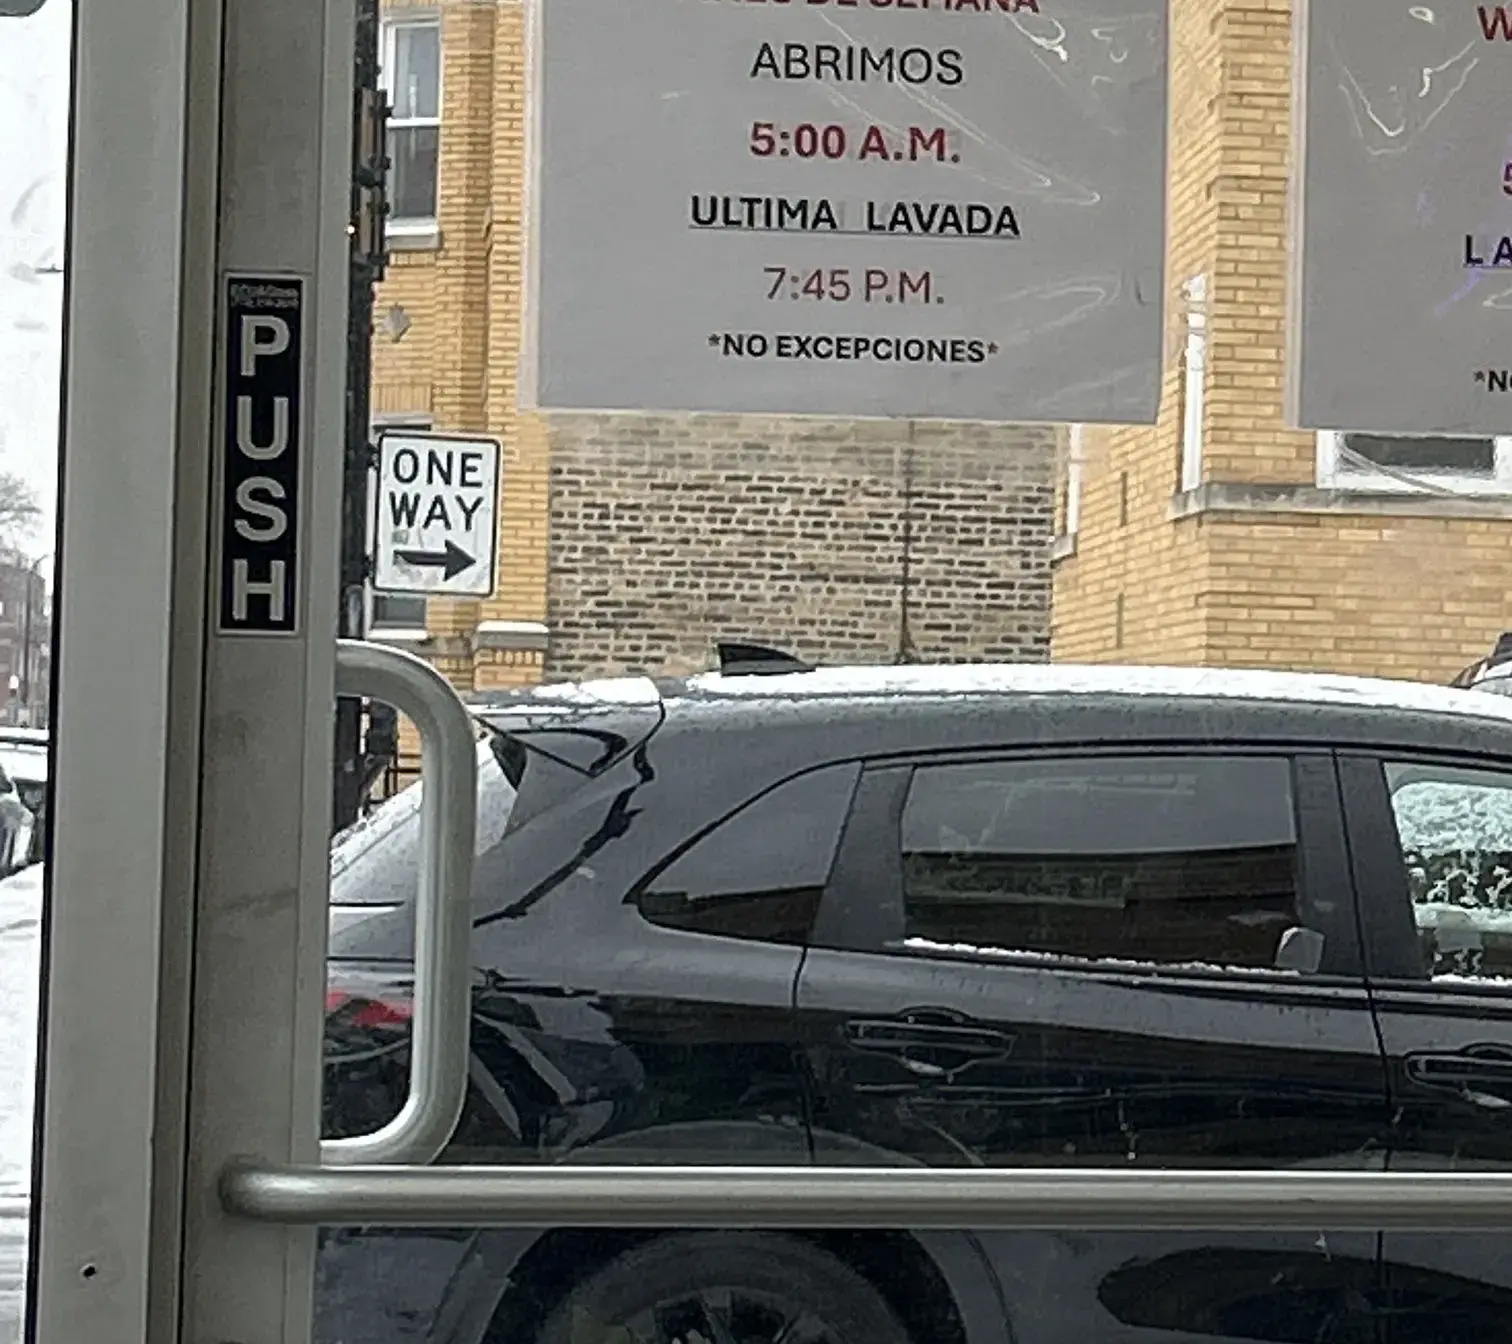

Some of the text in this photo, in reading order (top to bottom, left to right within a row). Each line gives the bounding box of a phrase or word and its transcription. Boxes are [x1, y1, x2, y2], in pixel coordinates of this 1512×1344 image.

[750, 43, 963, 86] ABRIMOS
[750, 123, 960, 163] 5:00 A.M.
[691, 195, 1019, 237] ULTIMA LAVADA
[764, 267, 944, 304] 7:45 P.M.
[232, 314, 290, 621] PUSH
[392, 448, 483, 488] ONE
[389, 492, 483, 532] WAY
